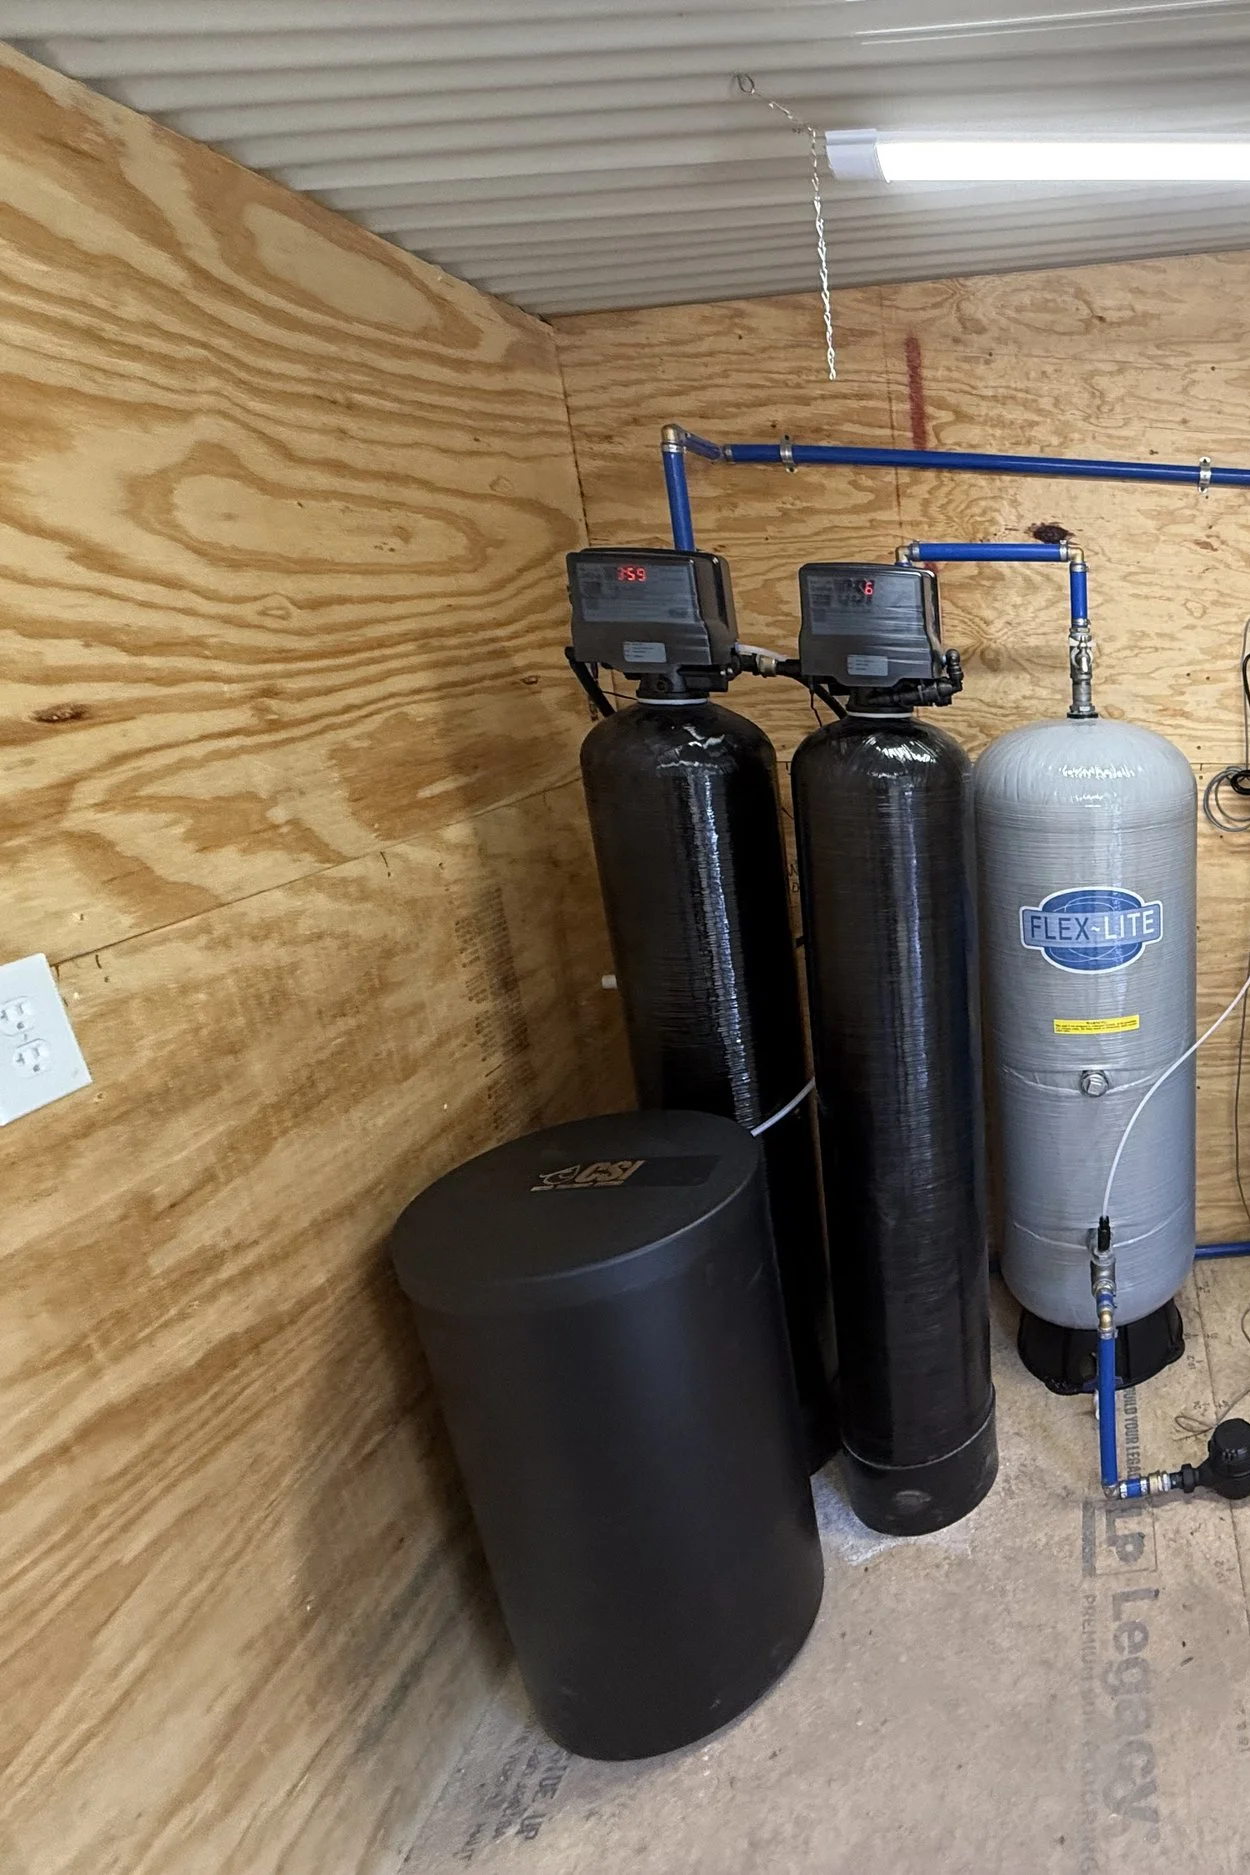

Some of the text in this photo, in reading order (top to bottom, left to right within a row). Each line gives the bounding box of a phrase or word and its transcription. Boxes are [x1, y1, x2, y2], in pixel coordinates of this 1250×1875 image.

[575, 1160, 646, 1183] CSI
[1124, 1415, 1140, 1445] YOUR
[1081, 1595, 1097, 1680] PREMIUM
[1103, 1588, 1160, 1824] Legacy
